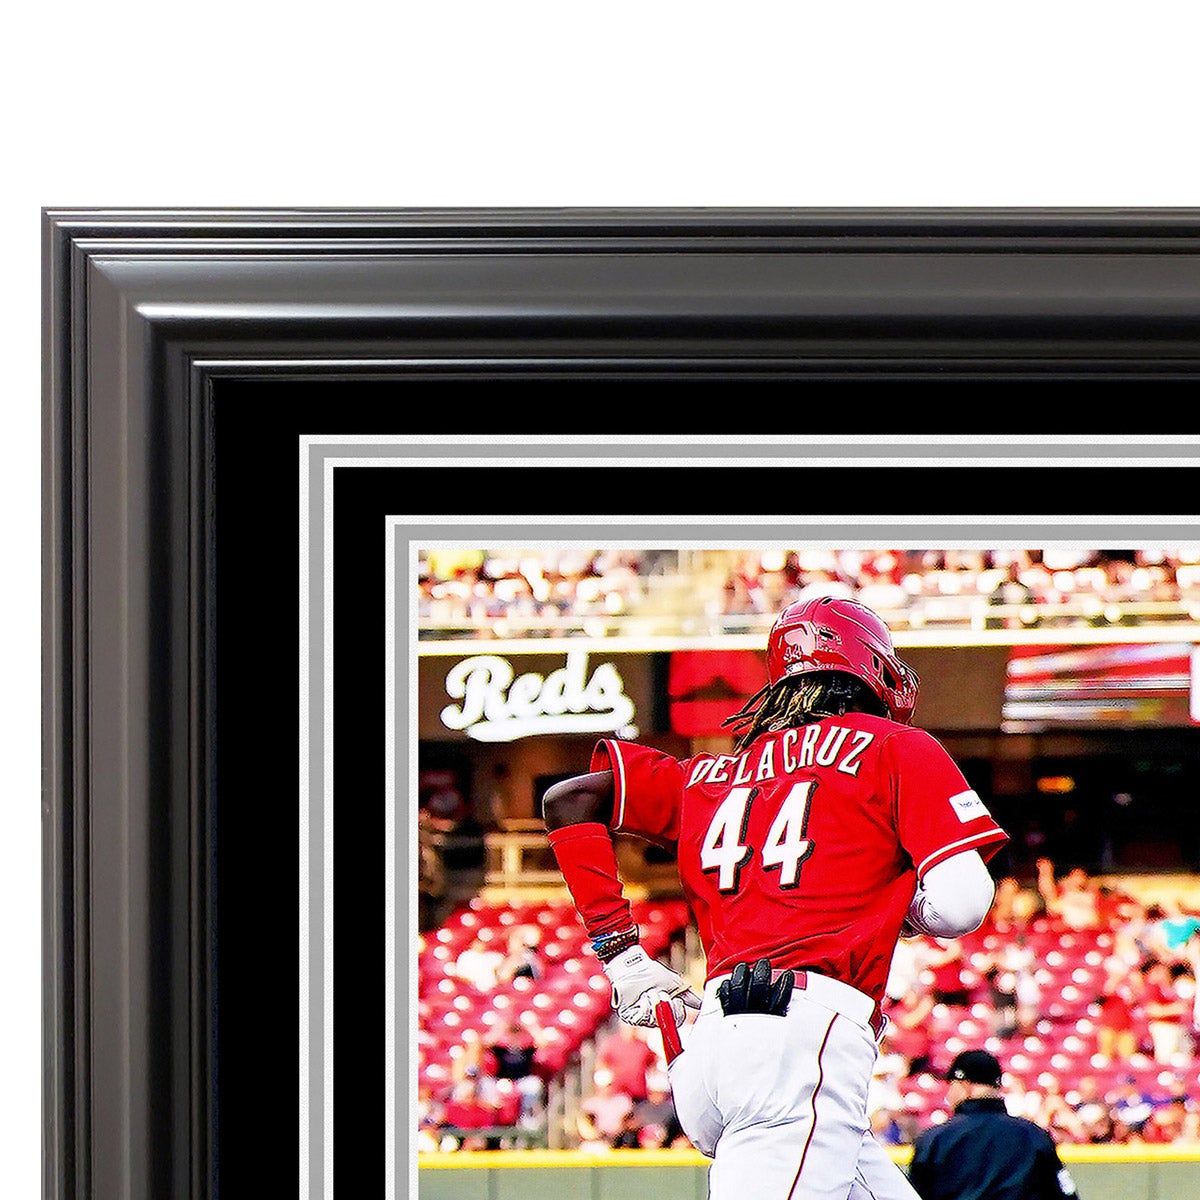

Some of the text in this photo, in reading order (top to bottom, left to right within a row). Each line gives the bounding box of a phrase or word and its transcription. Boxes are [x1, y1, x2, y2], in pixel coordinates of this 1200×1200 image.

[440, 651, 640, 742] Reds
[782, 723, 875, 777] CRUZ
[700, 780, 818, 895] 44
